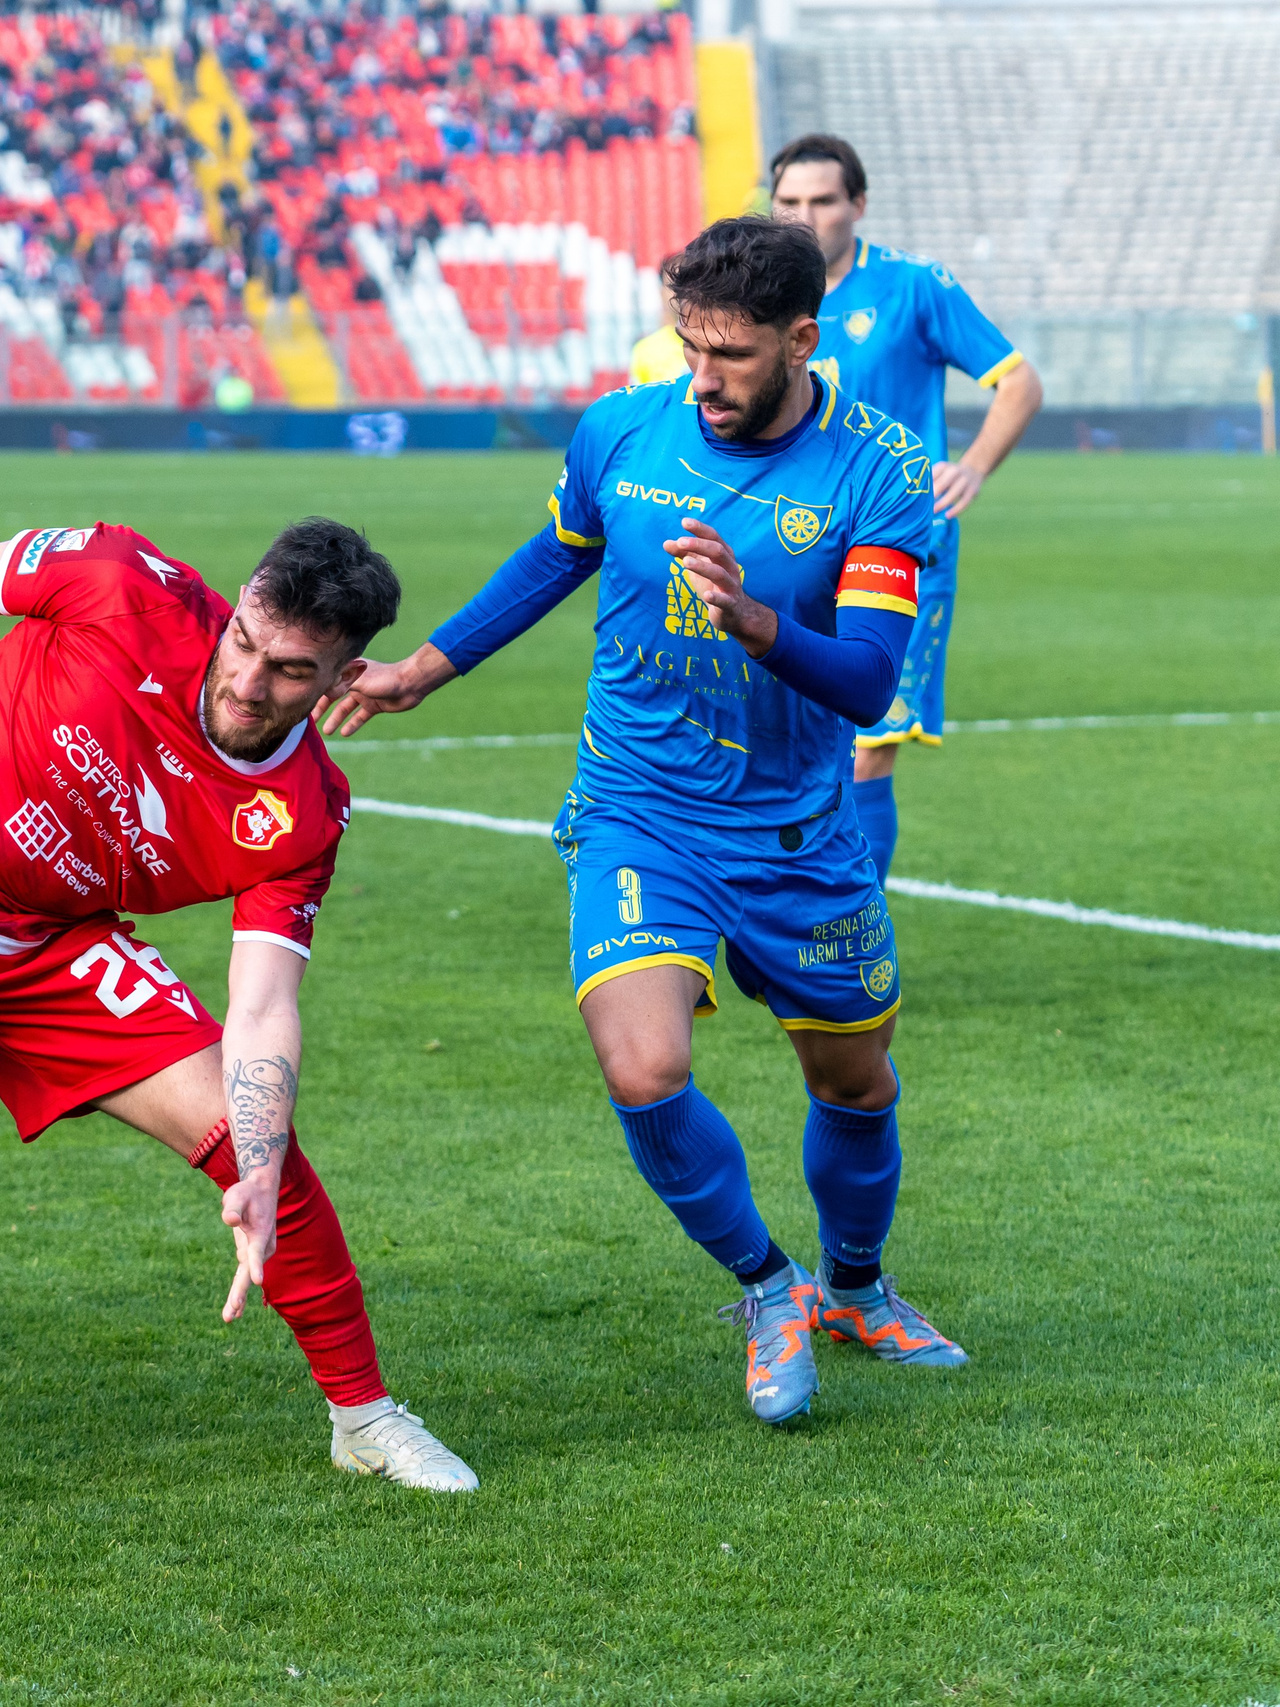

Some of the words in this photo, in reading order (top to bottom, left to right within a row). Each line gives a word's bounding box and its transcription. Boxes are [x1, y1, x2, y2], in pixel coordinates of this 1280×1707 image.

[616, 481, 706, 512] GIVOVA
[845, 563, 907, 580] GIVOVA
[75, 724, 131, 799] CENTRO
[46, 761, 68, 789] The
[67, 788, 94, 818] ERP
[52, 724, 171, 876] SOFTWARE
[53, 857, 90, 896] brews
[65, 851, 106, 887] carbon
[617, 867, 643, 925] 3
[588, 932, 678, 960] GIVOVA
[798, 941, 839, 968] MARMI
[846, 939, 855, 957] E
